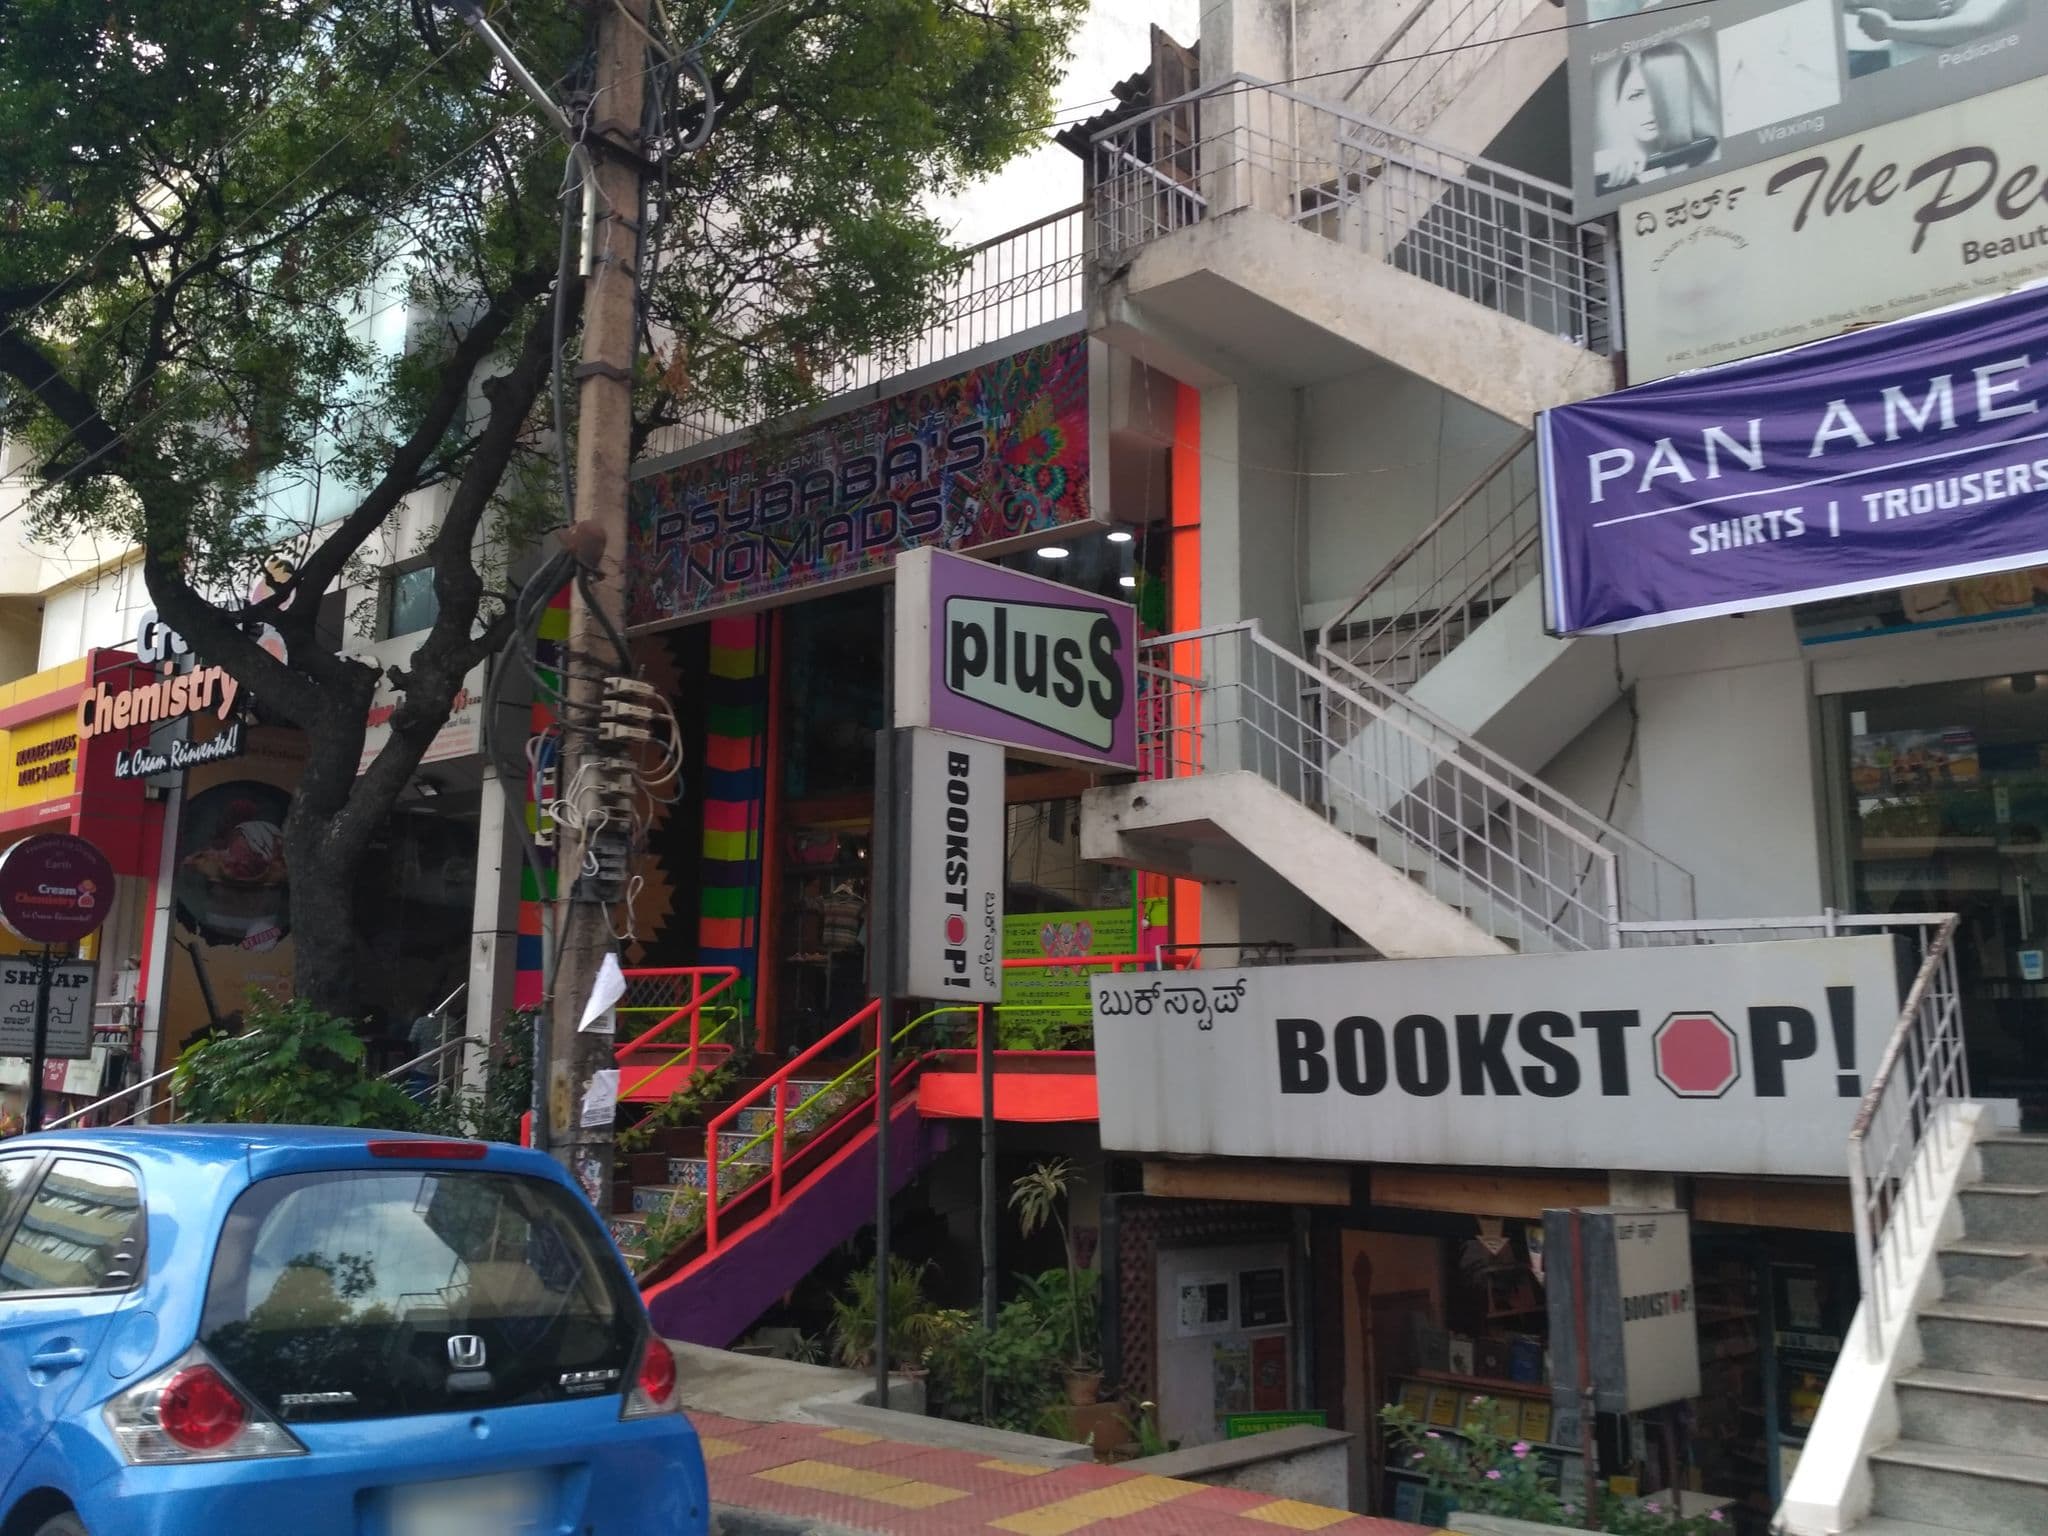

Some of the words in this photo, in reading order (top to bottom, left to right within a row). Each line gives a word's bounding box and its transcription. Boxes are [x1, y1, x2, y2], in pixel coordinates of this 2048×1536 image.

[1937, 32, 2020, 69] Pedicure
[1756, 115, 1826, 145] Waxing
[1766, 143, 1903, 233] The
[655, 421, 987, 556] PSYBABA'S
[687, 470, 759, 499] NATURAL
[766, 447, 834, 478] COSMIC
[842, 410, 947, 454] ELEMENTS
[1587, 418, 1766, 504] PAN
[683, 488, 946, 595] NOMADS
[1688, 506, 1805, 556] SHIRTS
[1861, 458, 2048, 523] TROUSERS
[76, 660, 239, 739] Chemistry
[115, 751, 129, 778] Ice
[131, 748, 168, 777] Cream
[170, 723, 240, 767] Reinvented!
[38, 883, 77, 896] Cream
